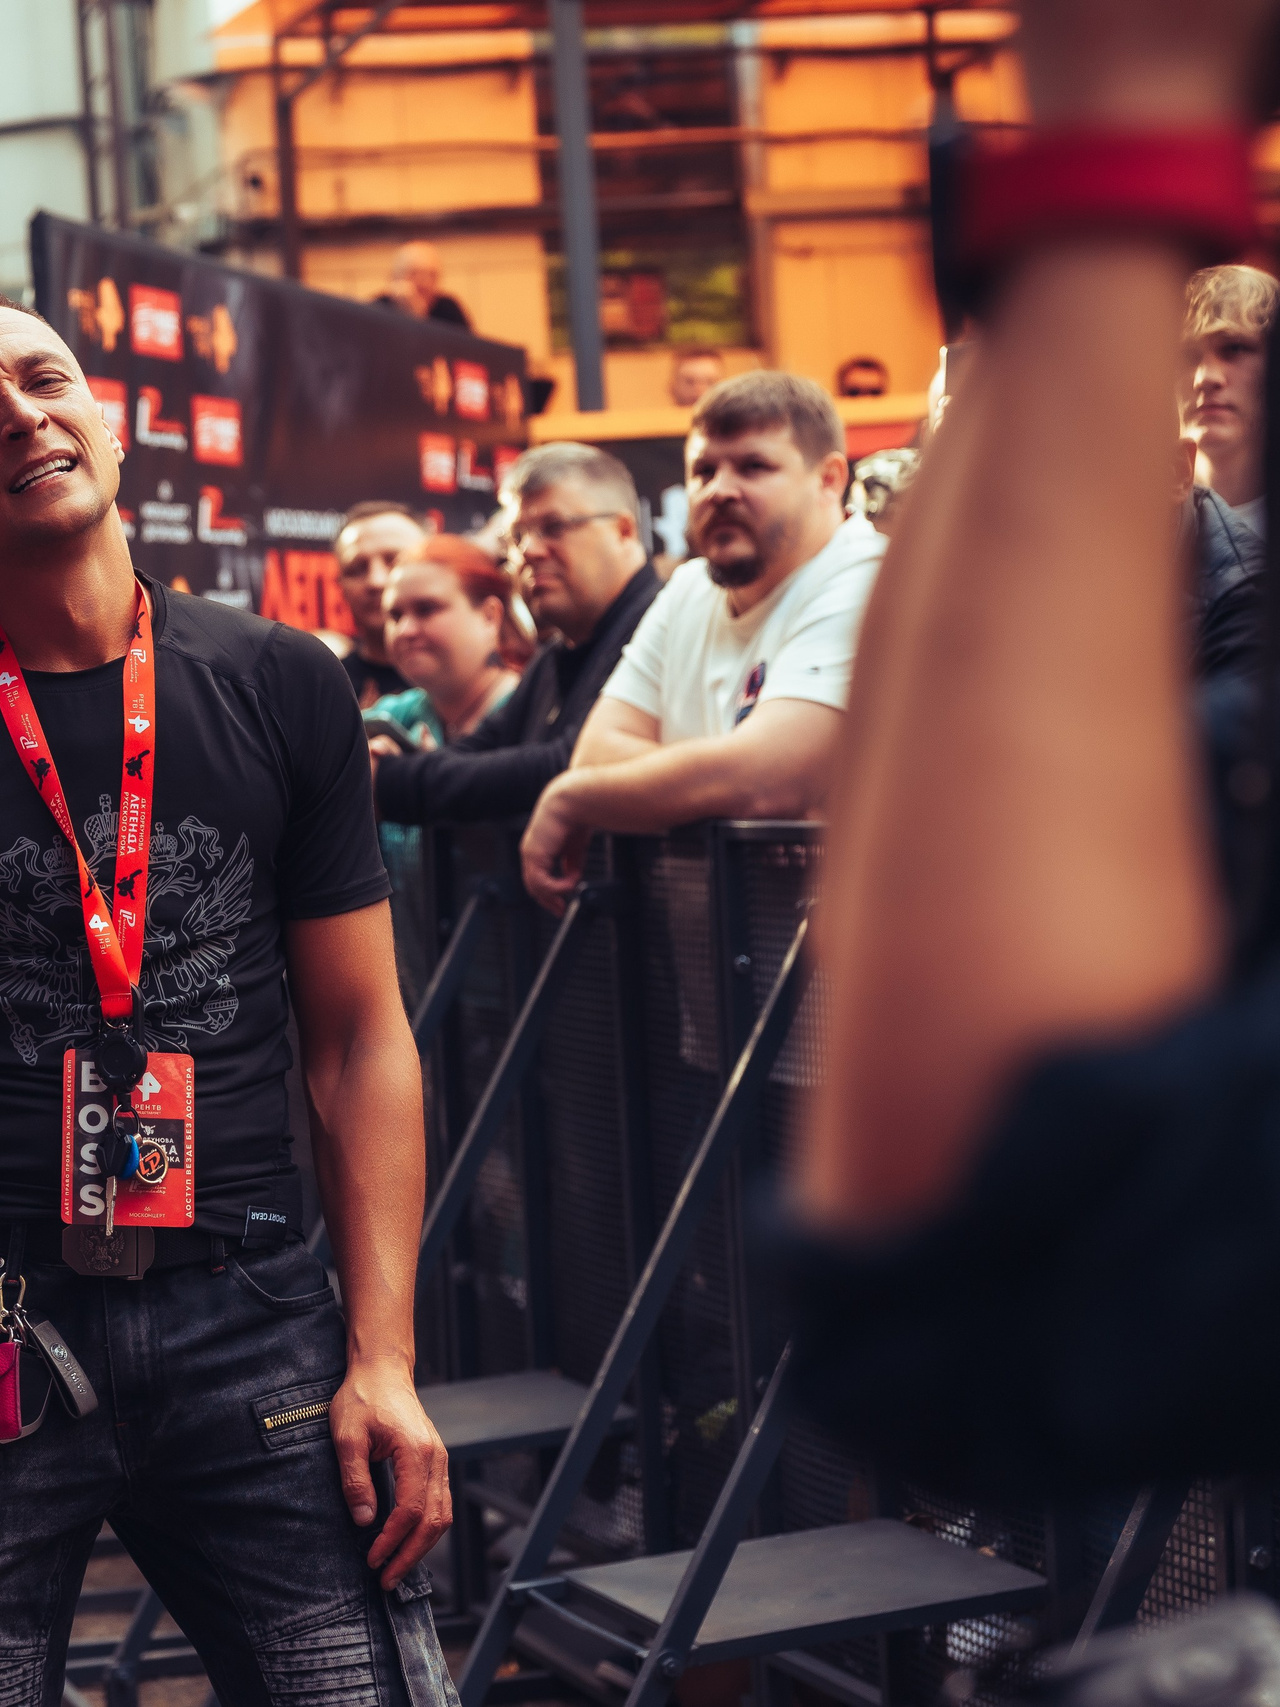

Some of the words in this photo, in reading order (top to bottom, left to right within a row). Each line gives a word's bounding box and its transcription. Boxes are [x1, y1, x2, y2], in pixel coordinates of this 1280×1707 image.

[6, 692, 15, 708] РЕН
[12, 690, 20, 701] ТВ
[132, 699, 138, 709] ТВ
[121, 791, 130, 832] РУССКОГО
[140, 798, 147, 809] ДК
[127, 793, 140, 855] ЛЕГЕНДА
[138, 811, 146, 851] ГОРБУНОВА
[98, 938, 108, 955] РЕН
[105, 937, 112, 949] ТВ
[67, 1094, 72, 1104] НА
[185, 1067, 193, 1120] ДОСМОТРА
[78, 1061, 109, 1216] BOSS
[185, 1143, 193, 1175] ВЕЗДЕ
[185, 1179, 193, 1219] ДОСТУП
[251, 1211, 268, 1221] GEAR
[268, 1212, 287, 1224] SPORT
